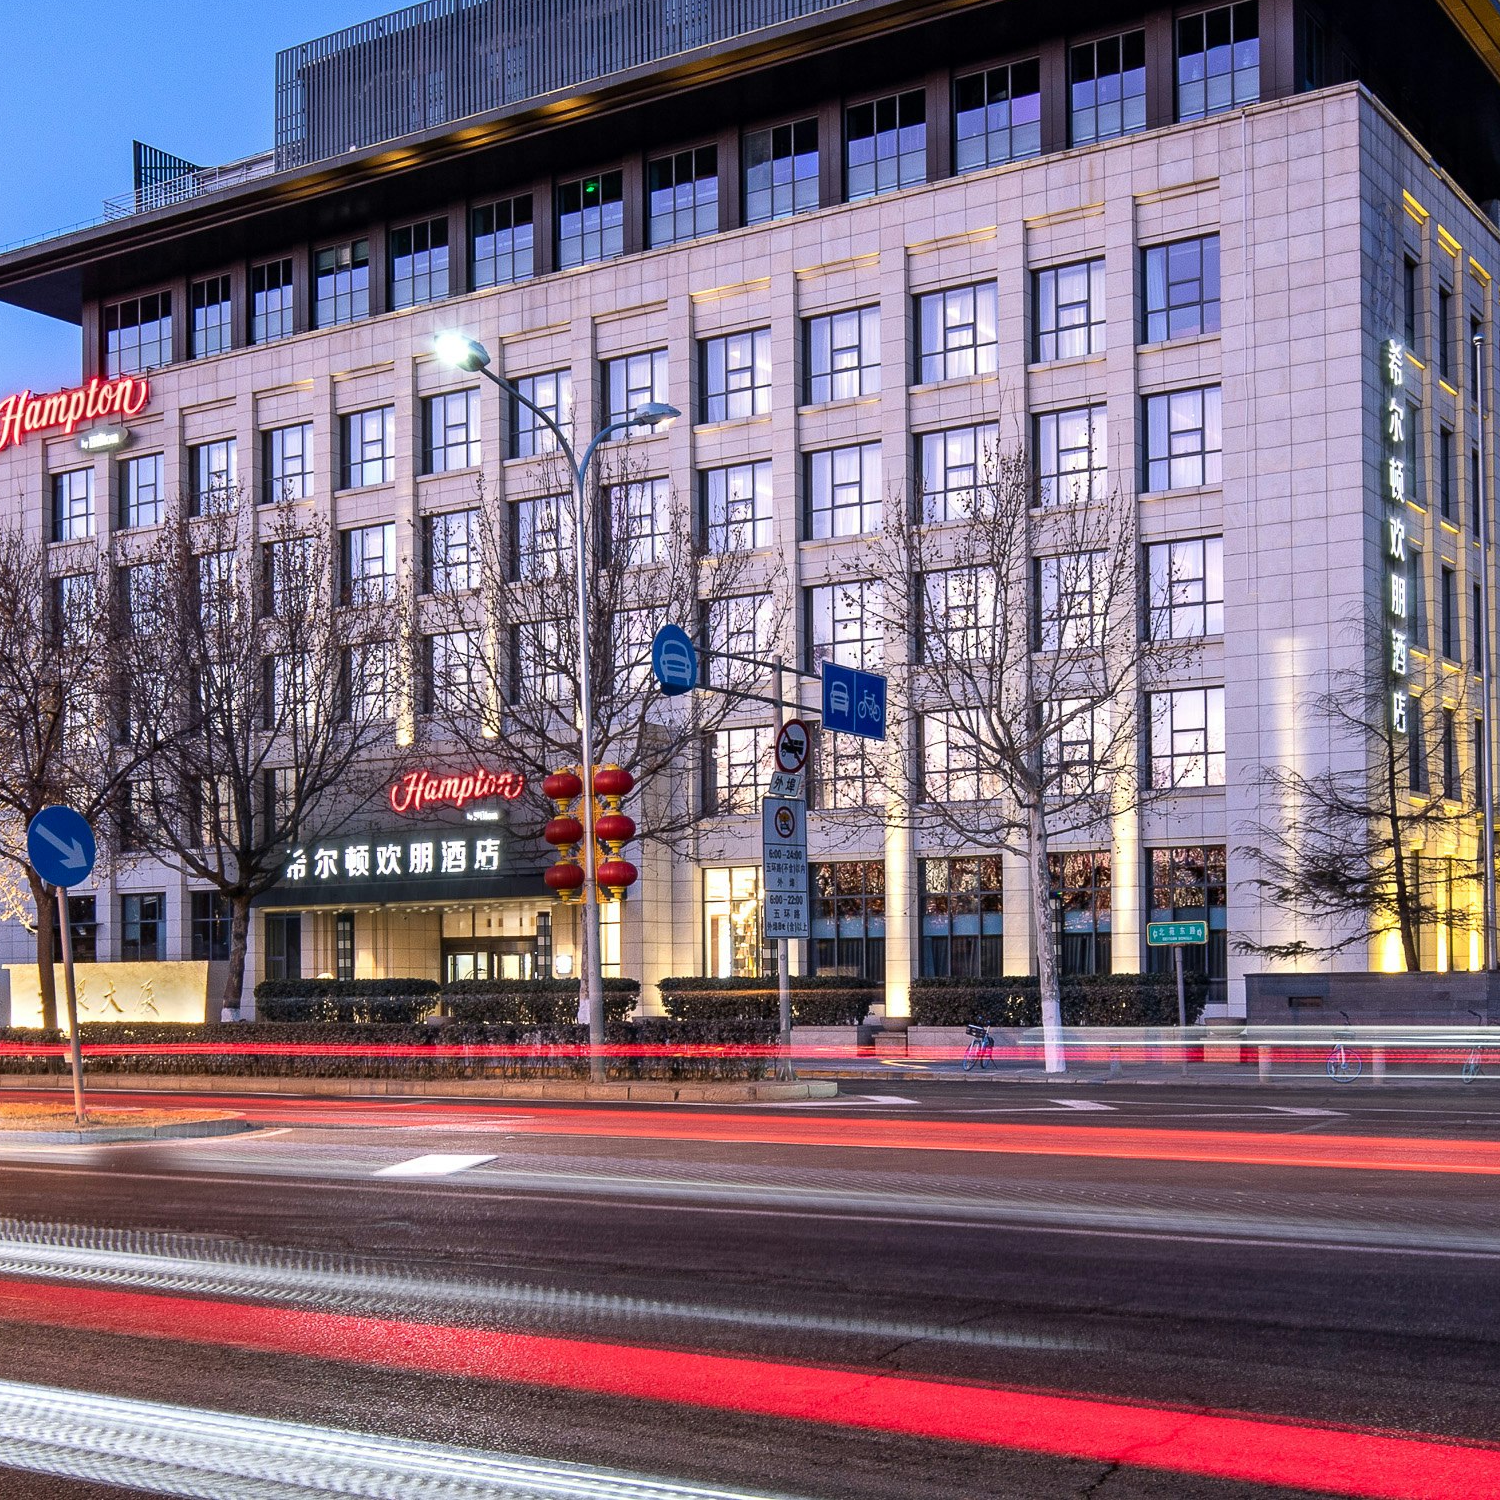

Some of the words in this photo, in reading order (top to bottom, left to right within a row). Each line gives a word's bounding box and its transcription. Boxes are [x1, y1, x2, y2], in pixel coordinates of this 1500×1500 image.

[1387, 339, 1406, 733] 希尔顿欢朋酒店
[390, 768, 523, 812] Hampton
[773, 775, 796, 793] 外埠
[286, 838, 500, 880] 希尔顿欢朋酒店
